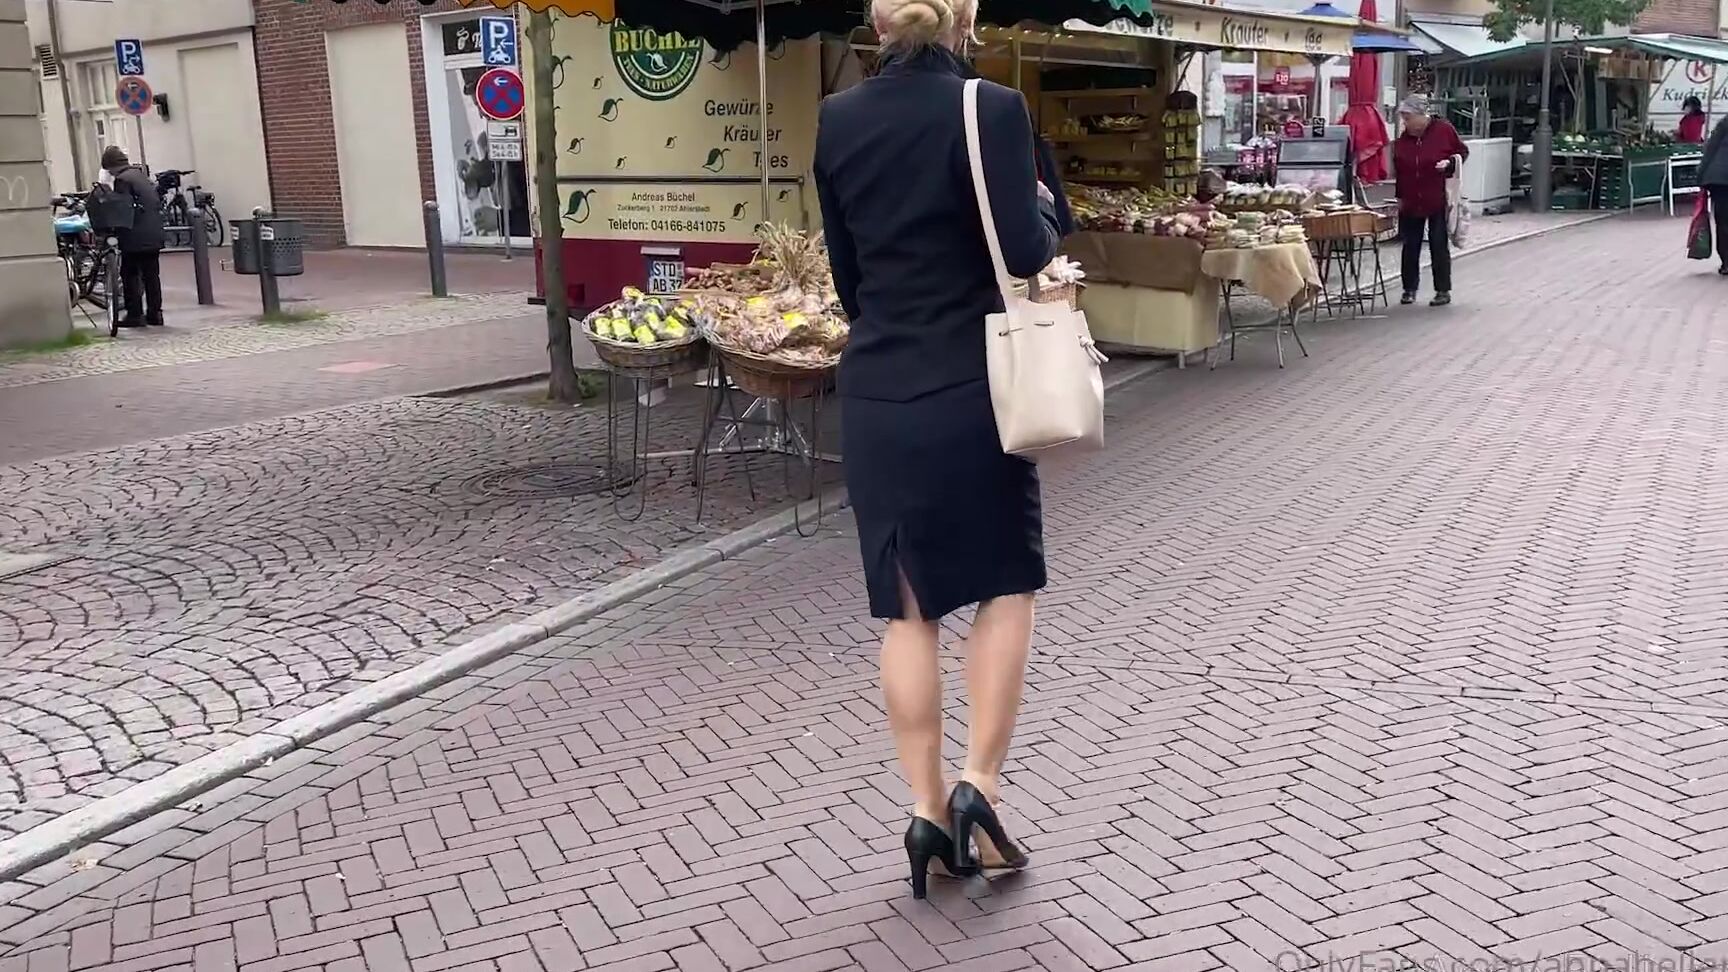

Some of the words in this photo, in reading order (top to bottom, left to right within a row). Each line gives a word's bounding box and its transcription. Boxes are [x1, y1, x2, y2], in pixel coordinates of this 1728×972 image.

[489, 21, 508, 48] P
[121, 42, 136, 63] P
[724, 124, 782, 142] Kräuer
[753, 151, 789, 168] Tes
[632, 192, 664, 202] Andreas
[608, 218, 648, 231] Telefon:
[651, 219, 726, 232] 04166-841075
[653, 263, 676, 277] STD
[653, 278, 667, 292] AB
